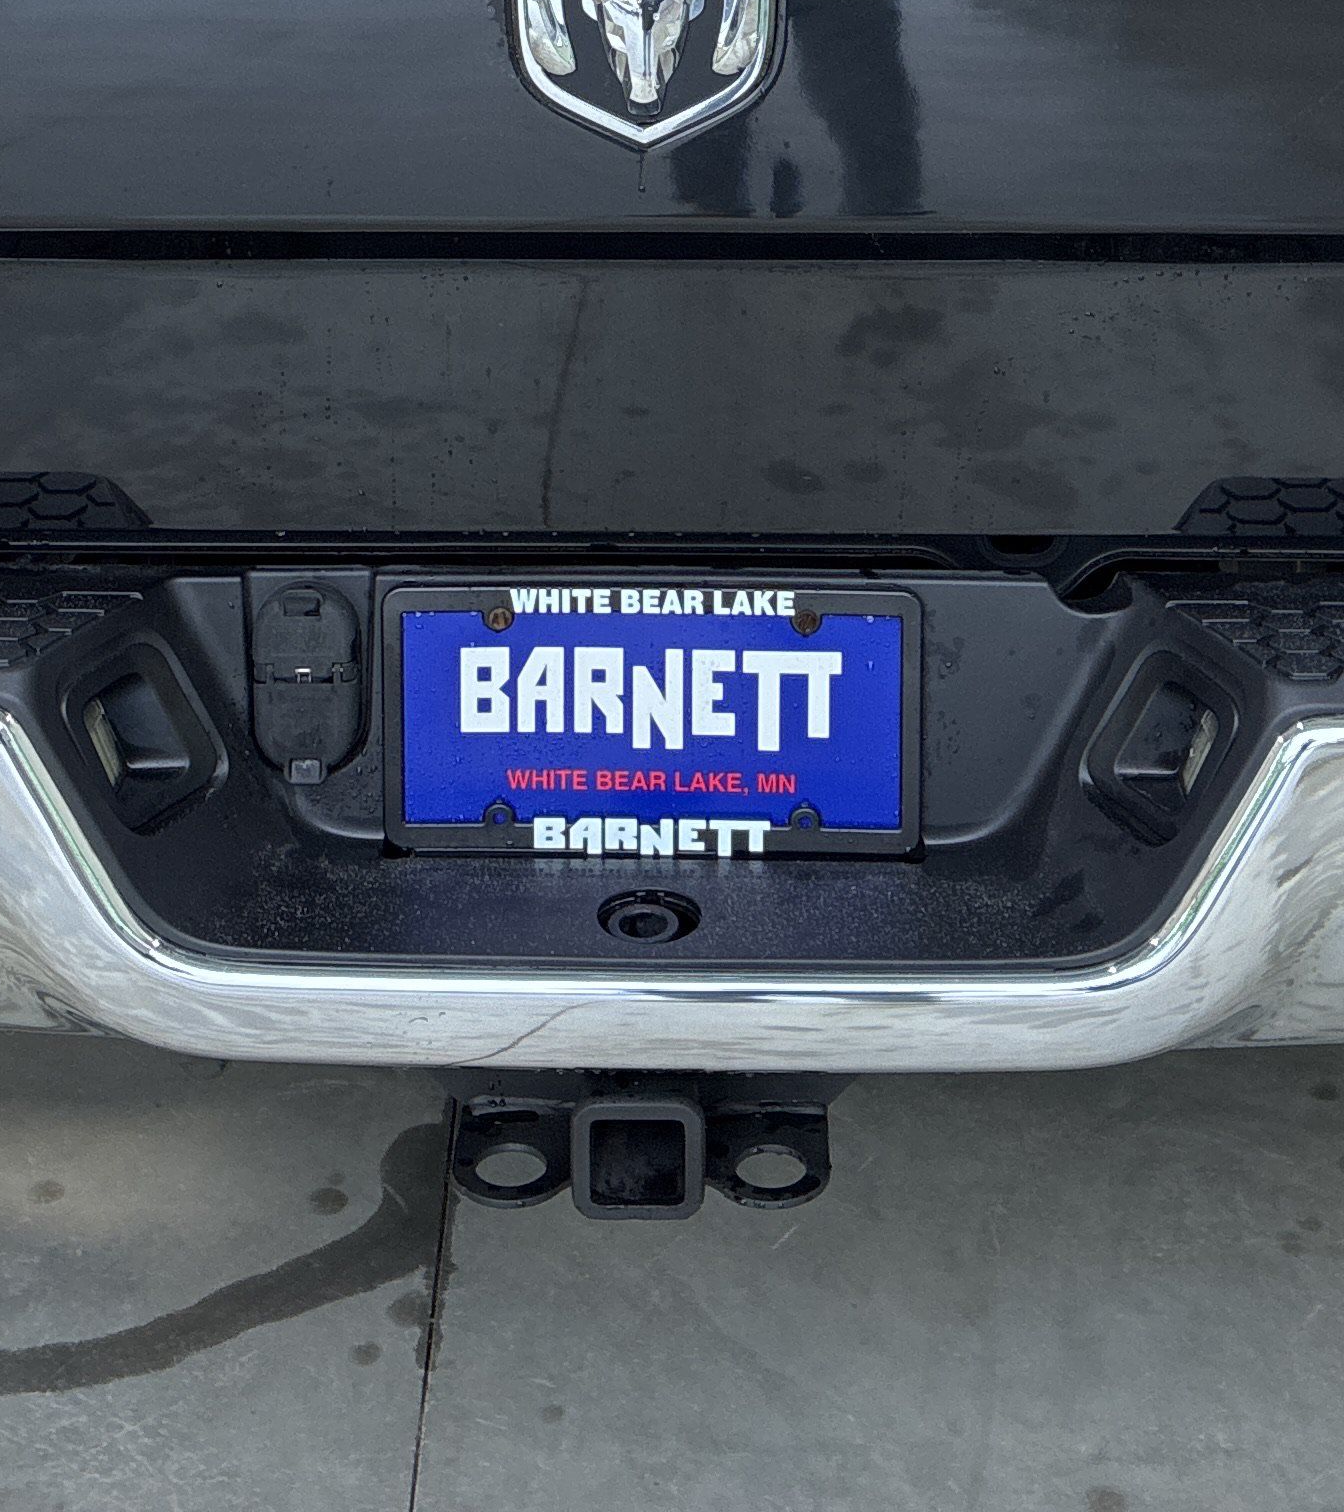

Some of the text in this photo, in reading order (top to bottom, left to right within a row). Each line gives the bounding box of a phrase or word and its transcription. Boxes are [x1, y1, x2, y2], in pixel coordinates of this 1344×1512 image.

[509, 587, 796, 617] WHITE BEAR LAKE
[459, 645, 843, 752] BARNETT
[506, 768, 796, 796] WHITE BEAR LAKE, MN
[532, 816, 771, 857] BARNETT
